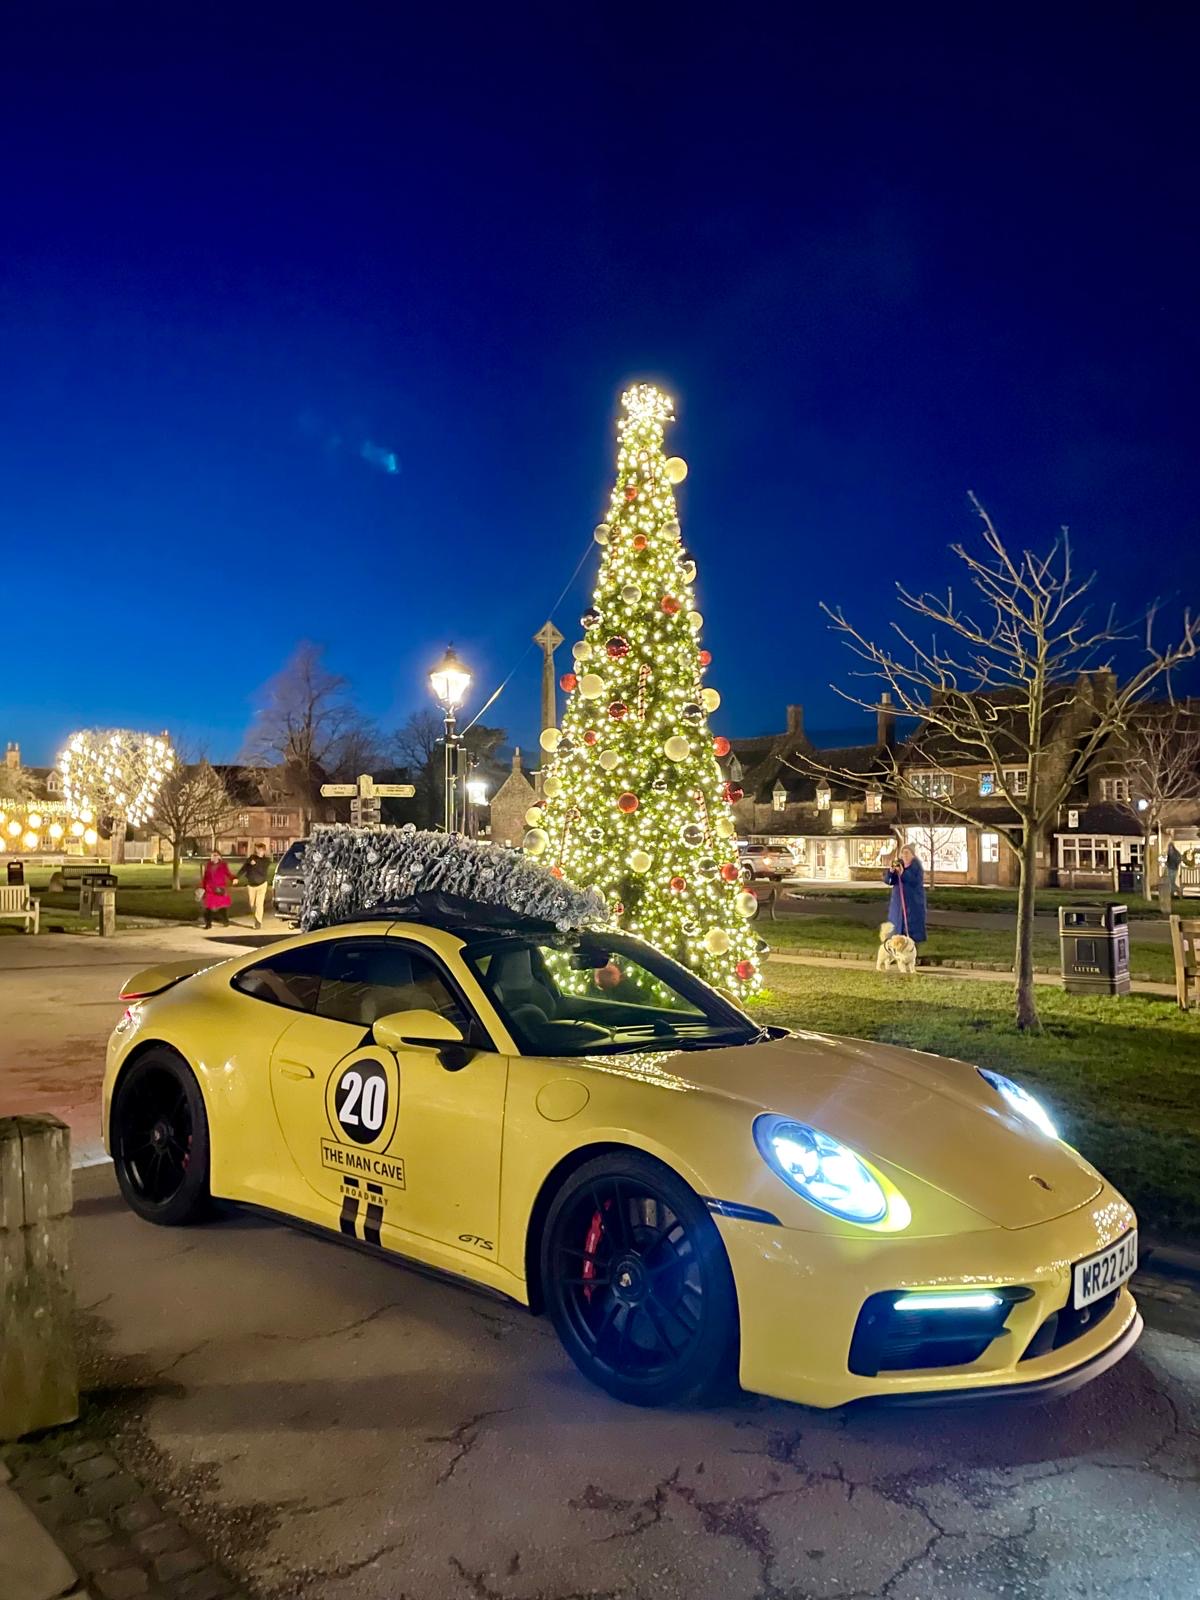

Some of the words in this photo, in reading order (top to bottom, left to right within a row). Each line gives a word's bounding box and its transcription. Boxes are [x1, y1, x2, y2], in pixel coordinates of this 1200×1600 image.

[339, 1071, 386, 1131] 20
[323, 1146, 344, 1165] THE
[345, 1152, 371, 1173] MAN
[373, 1160, 403, 1181] CAVE
[340, 1185, 388, 1207] BROADWAY
[458, 1234, 494, 1251] GTS
